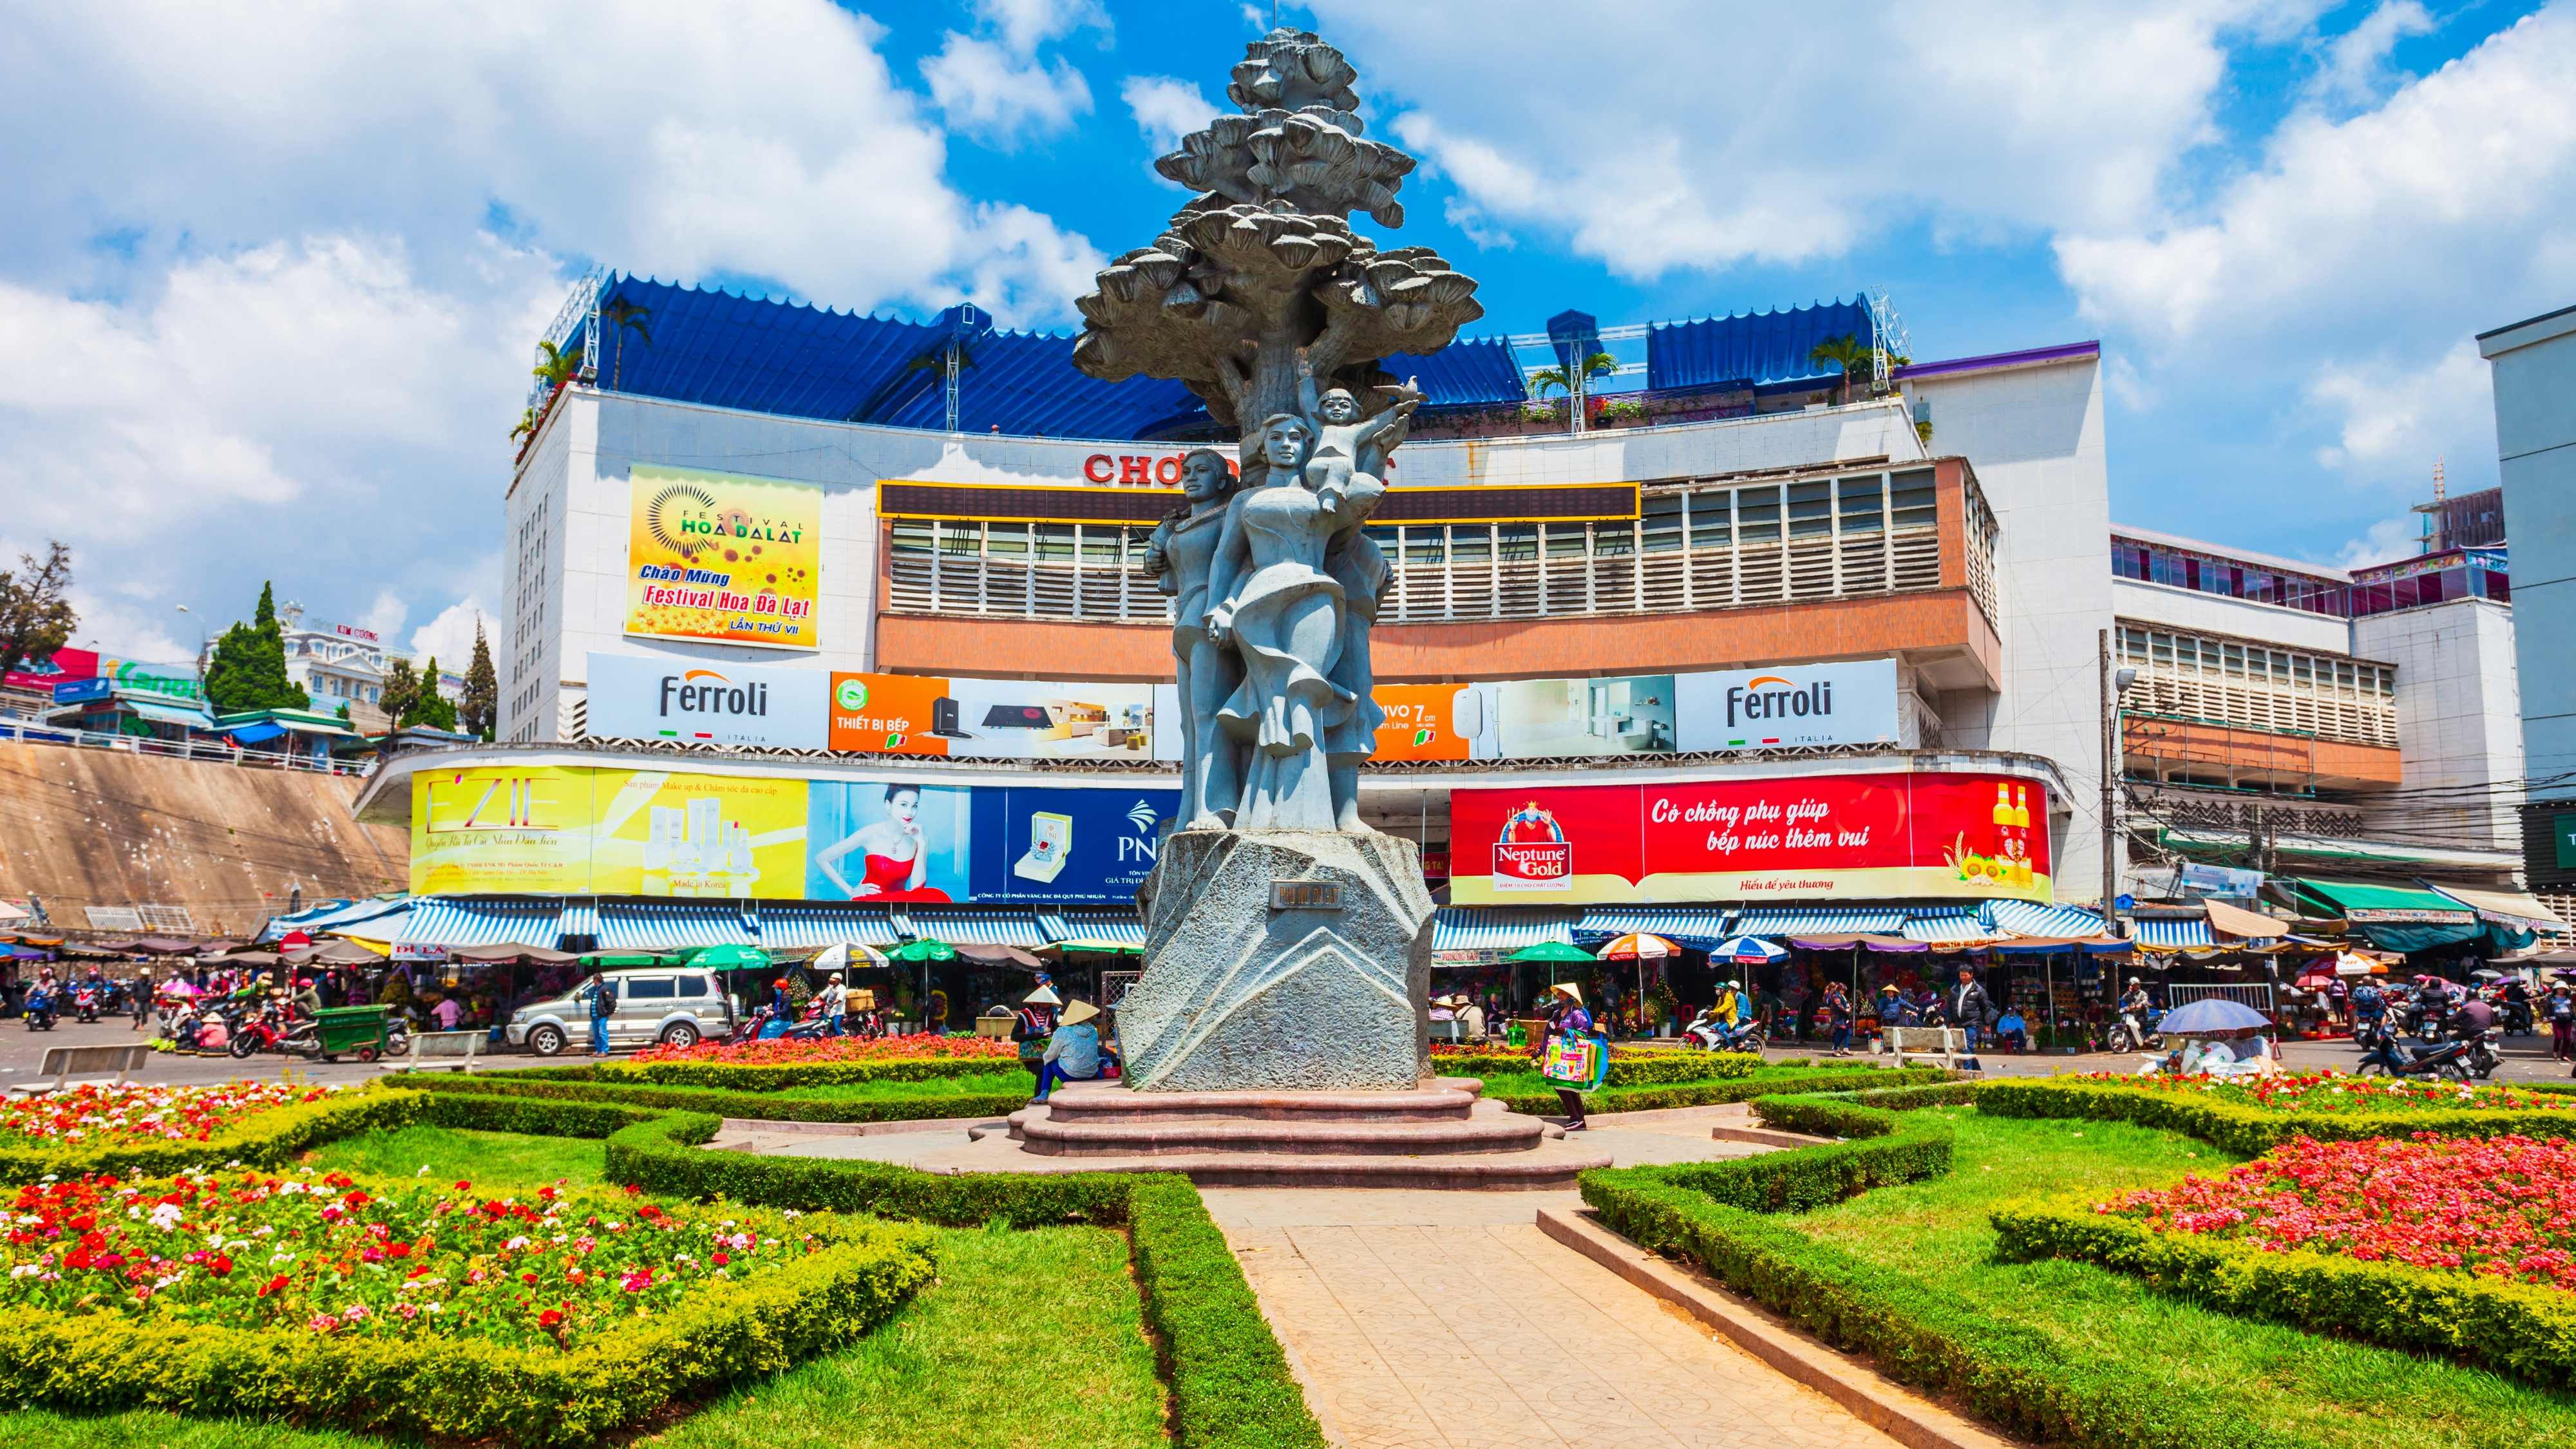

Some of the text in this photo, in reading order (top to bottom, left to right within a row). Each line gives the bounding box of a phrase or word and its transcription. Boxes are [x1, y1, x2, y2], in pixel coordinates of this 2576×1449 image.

[1084, 453, 1185, 489] CHỢ
[683, 510, 803, 529] FESTIVAL
[681, 519, 802, 544] HOA DALAT
[685, 569, 730, 587] Mừng
[644, 585, 810, 620] Festival Hoa Đà Lạt
[757, 622, 783, 634] THỨ
[785, 625, 799, 634] VII
[1379, 705, 1410, 717] IVO
[1414, 705, 1425, 722] 7
[837, 715, 909, 732] THIẾT BỊ BẾP
[661, 782, 682, 791] Make
[741, 784, 750, 793] da
[1651, 797, 1830, 829] Có chồng phụ giúp
[1118, 837, 1157, 861] PN
[1707, 826, 1870, 855] bếp núc thêm vui
[1498, 847, 1566, 864] Neptune
[1524, 861, 1562, 876] Gold
[1740, 878, 1834, 892] Hiểu để yêu thương
